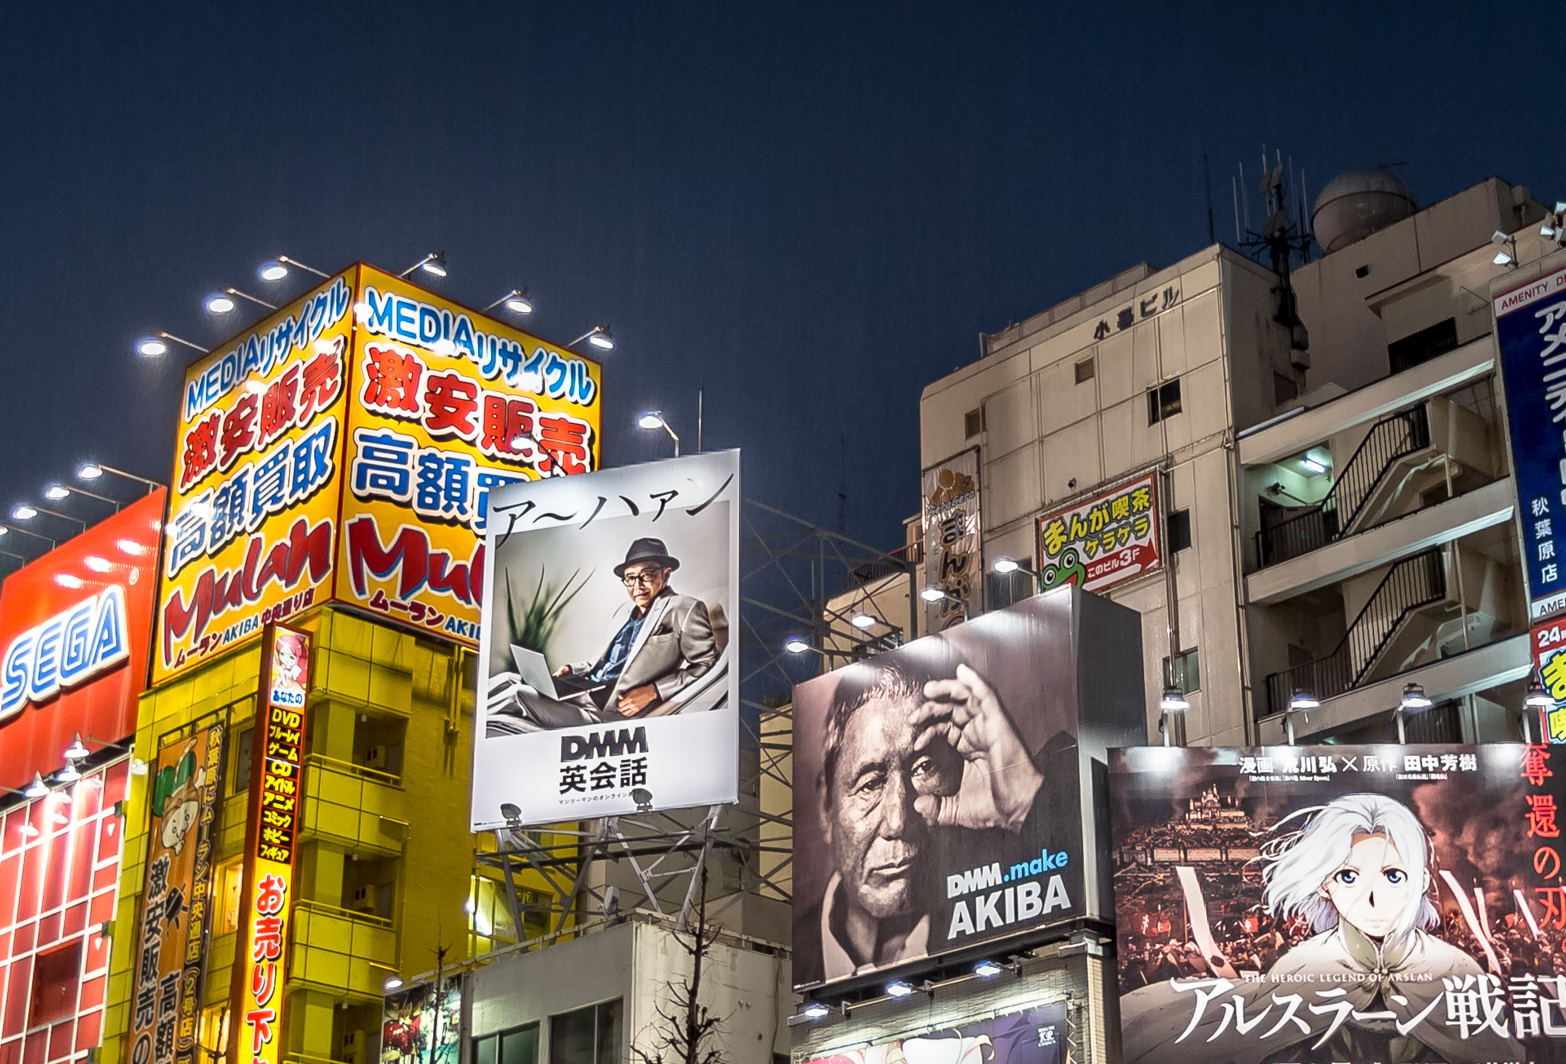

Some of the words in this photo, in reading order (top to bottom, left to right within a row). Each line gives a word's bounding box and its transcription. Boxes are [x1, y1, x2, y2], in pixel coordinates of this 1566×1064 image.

[1501, 281, 1549, 311] AMENITY
[186, 278, 349, 419] MEDIAリサイクル
[181, 337, 345, 490] 激安販売
[361, 345, 591, 476] 激安販売
[170, 417, 334, 577] 高額買取
[1043, 487, 1151, 558] まんが喫茶
[1085, 517, 1151, 560] ゲラゲラ
[1532, 496, 1558, 583] 秋葉原店
[163, 519, 332, 667] Mulan
[272, 710, 300, 727] DVD
[268, 741, 299, 760] ゲーム
[560, 726, 649, 763] DMM
[1239, 756, 1273, 774] 漫画
[1404, 754, 1477, 772] 田中芳樹
[272, 761, 291, 776] CD
[559, 756, 648, 795] 英会話
[263, 793, 294, 811] アニメ
[262, 827, 289, 844] ホビー
[946, 848, 1069, 899] DMM.make
[946, 874, 1072, 941] AKIBA
[1270, 973, 1315, 983] HEROIC
[1319, 973, 1365, 983] LEGEND
